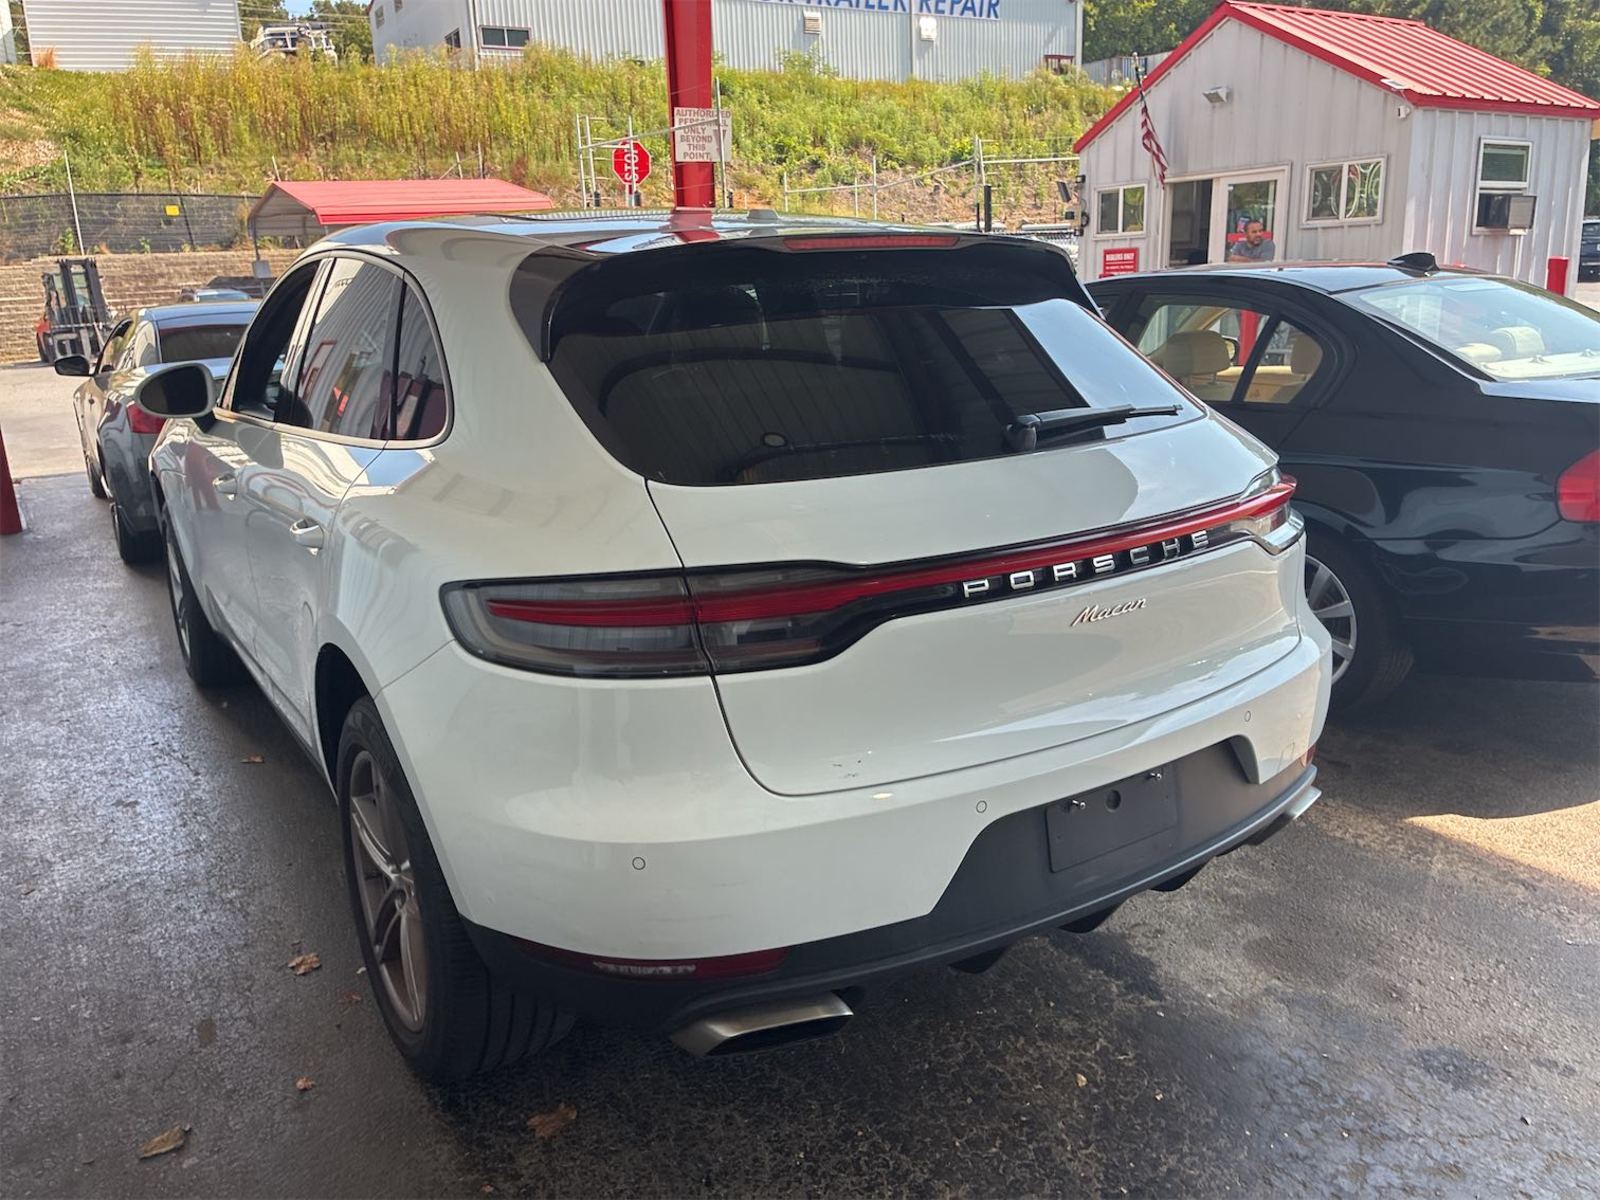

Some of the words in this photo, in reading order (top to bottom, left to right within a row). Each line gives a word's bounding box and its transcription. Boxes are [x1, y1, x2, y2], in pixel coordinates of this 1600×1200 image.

[919, 0, 999, 19] REPAIR
[680, 135, 712, 143] BEYOND
[684, 126, 706, 135] ONLY
[624, 144, 639, 181] STO
[963, 530, 1209, 598] PORSCHE
[1070, 598, 1147, 627] Macan
